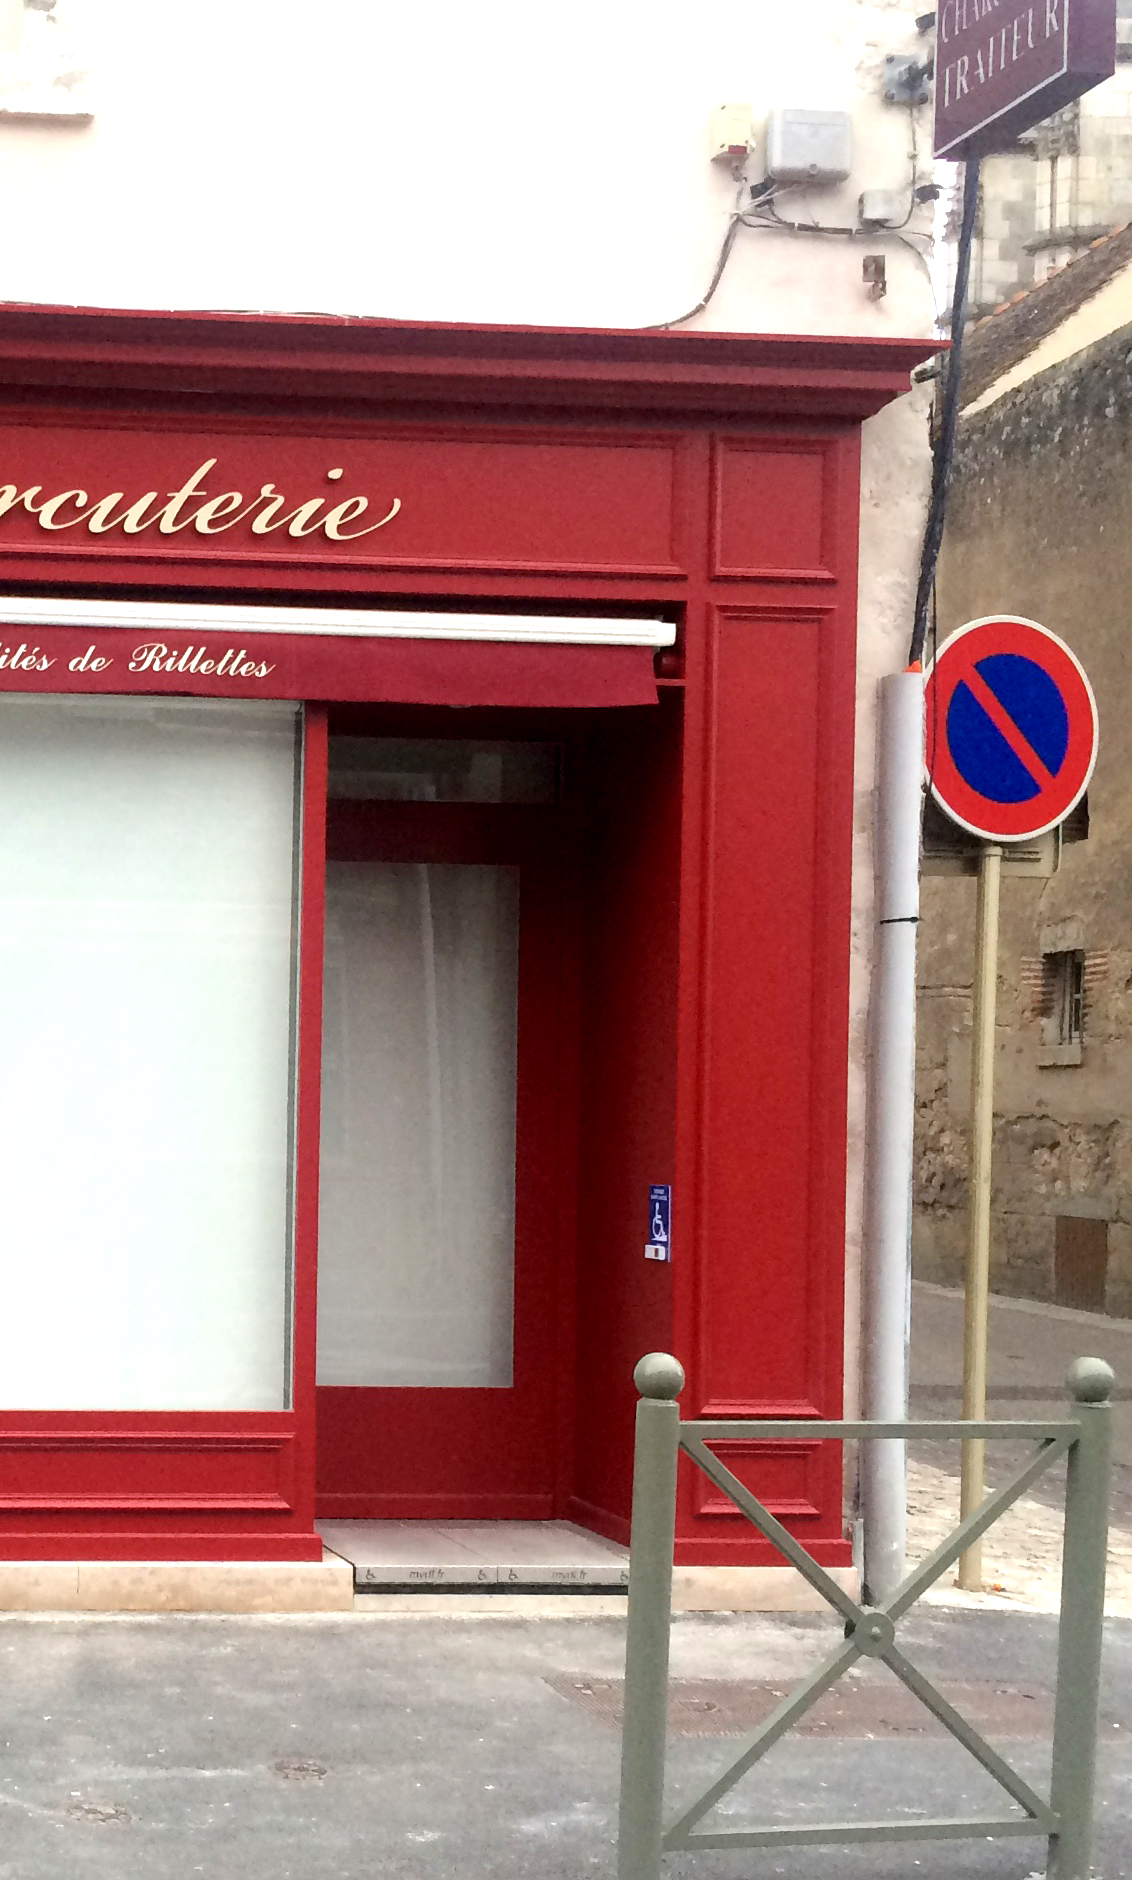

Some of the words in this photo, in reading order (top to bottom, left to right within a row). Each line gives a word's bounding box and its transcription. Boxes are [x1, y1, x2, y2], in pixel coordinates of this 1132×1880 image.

[943, 0, 1060, 108] TRAITEUR
[68, 645, 114, 673] de
[128, 643, 276, 678] Rillettes
